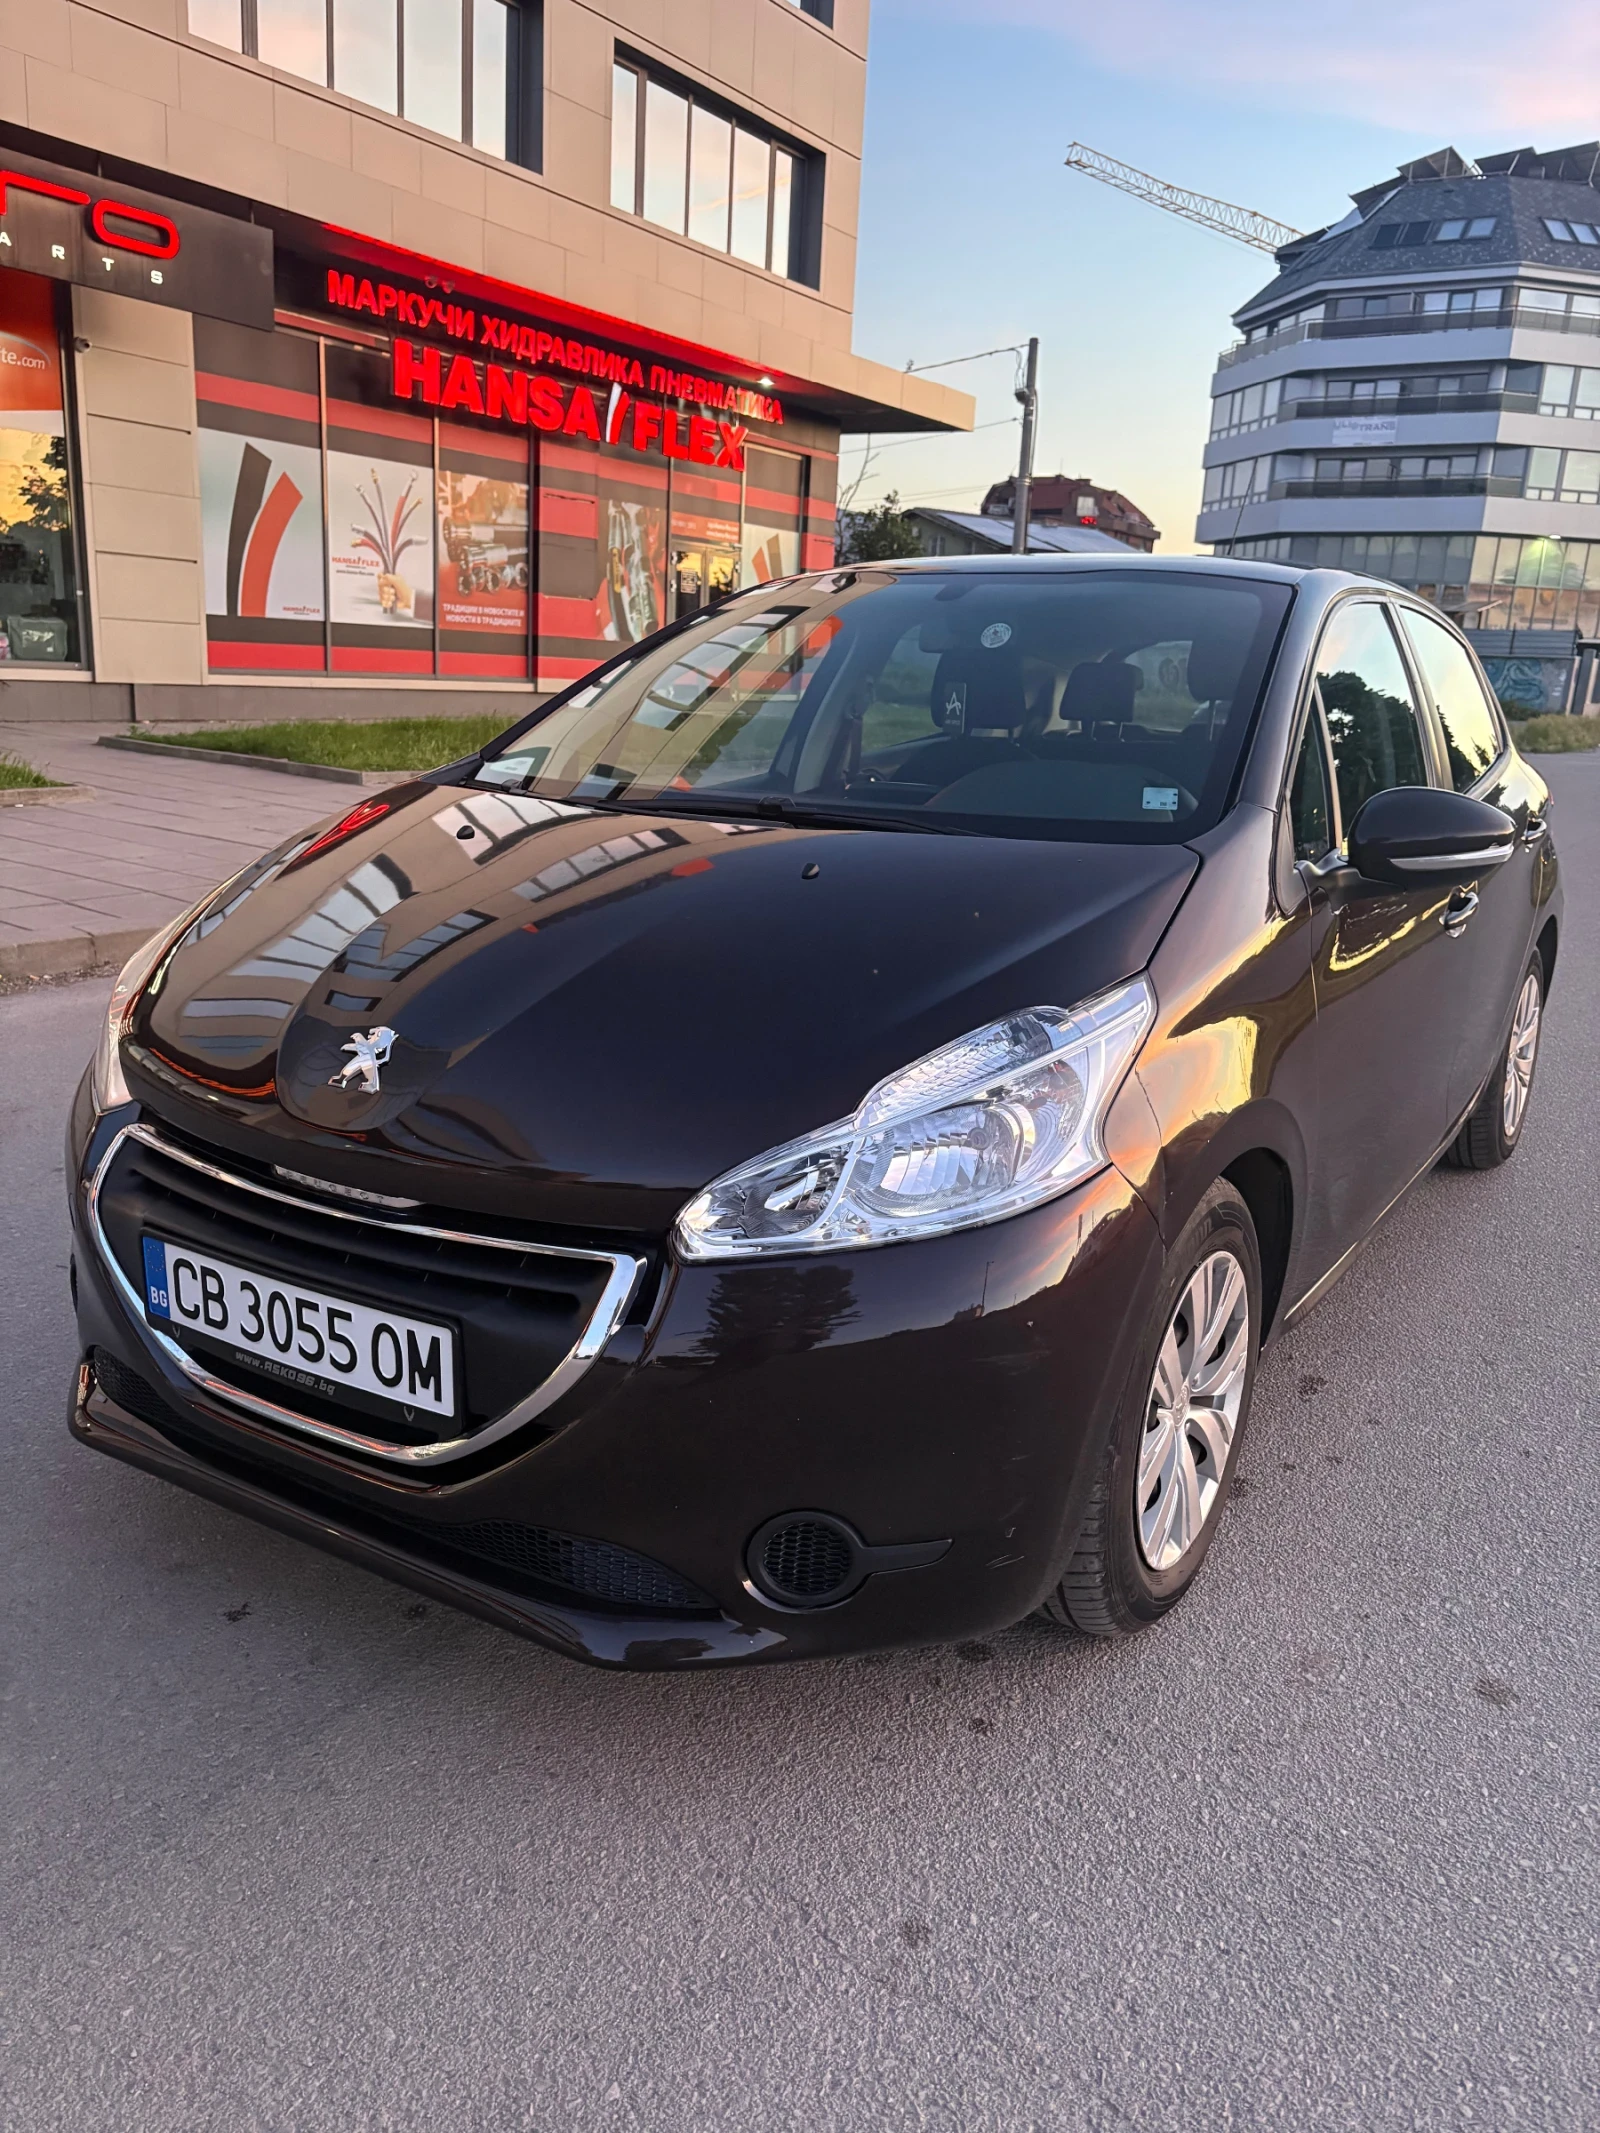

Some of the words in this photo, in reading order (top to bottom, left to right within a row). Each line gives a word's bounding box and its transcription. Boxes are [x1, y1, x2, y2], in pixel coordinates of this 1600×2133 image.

[327, 269, 475, 341] МАРКУЧИ
[480, 314, 644, 388] ХИДРАВЛИКА
[650, 364, 784, 425] ПНЕВМАТИКА
[150, 1286, 168, 1308] BG
[172, 1257, 229, 1331] CB
[239, 1280, 358, 1374] 3055
[371, 1322, 442, 1403] OM
